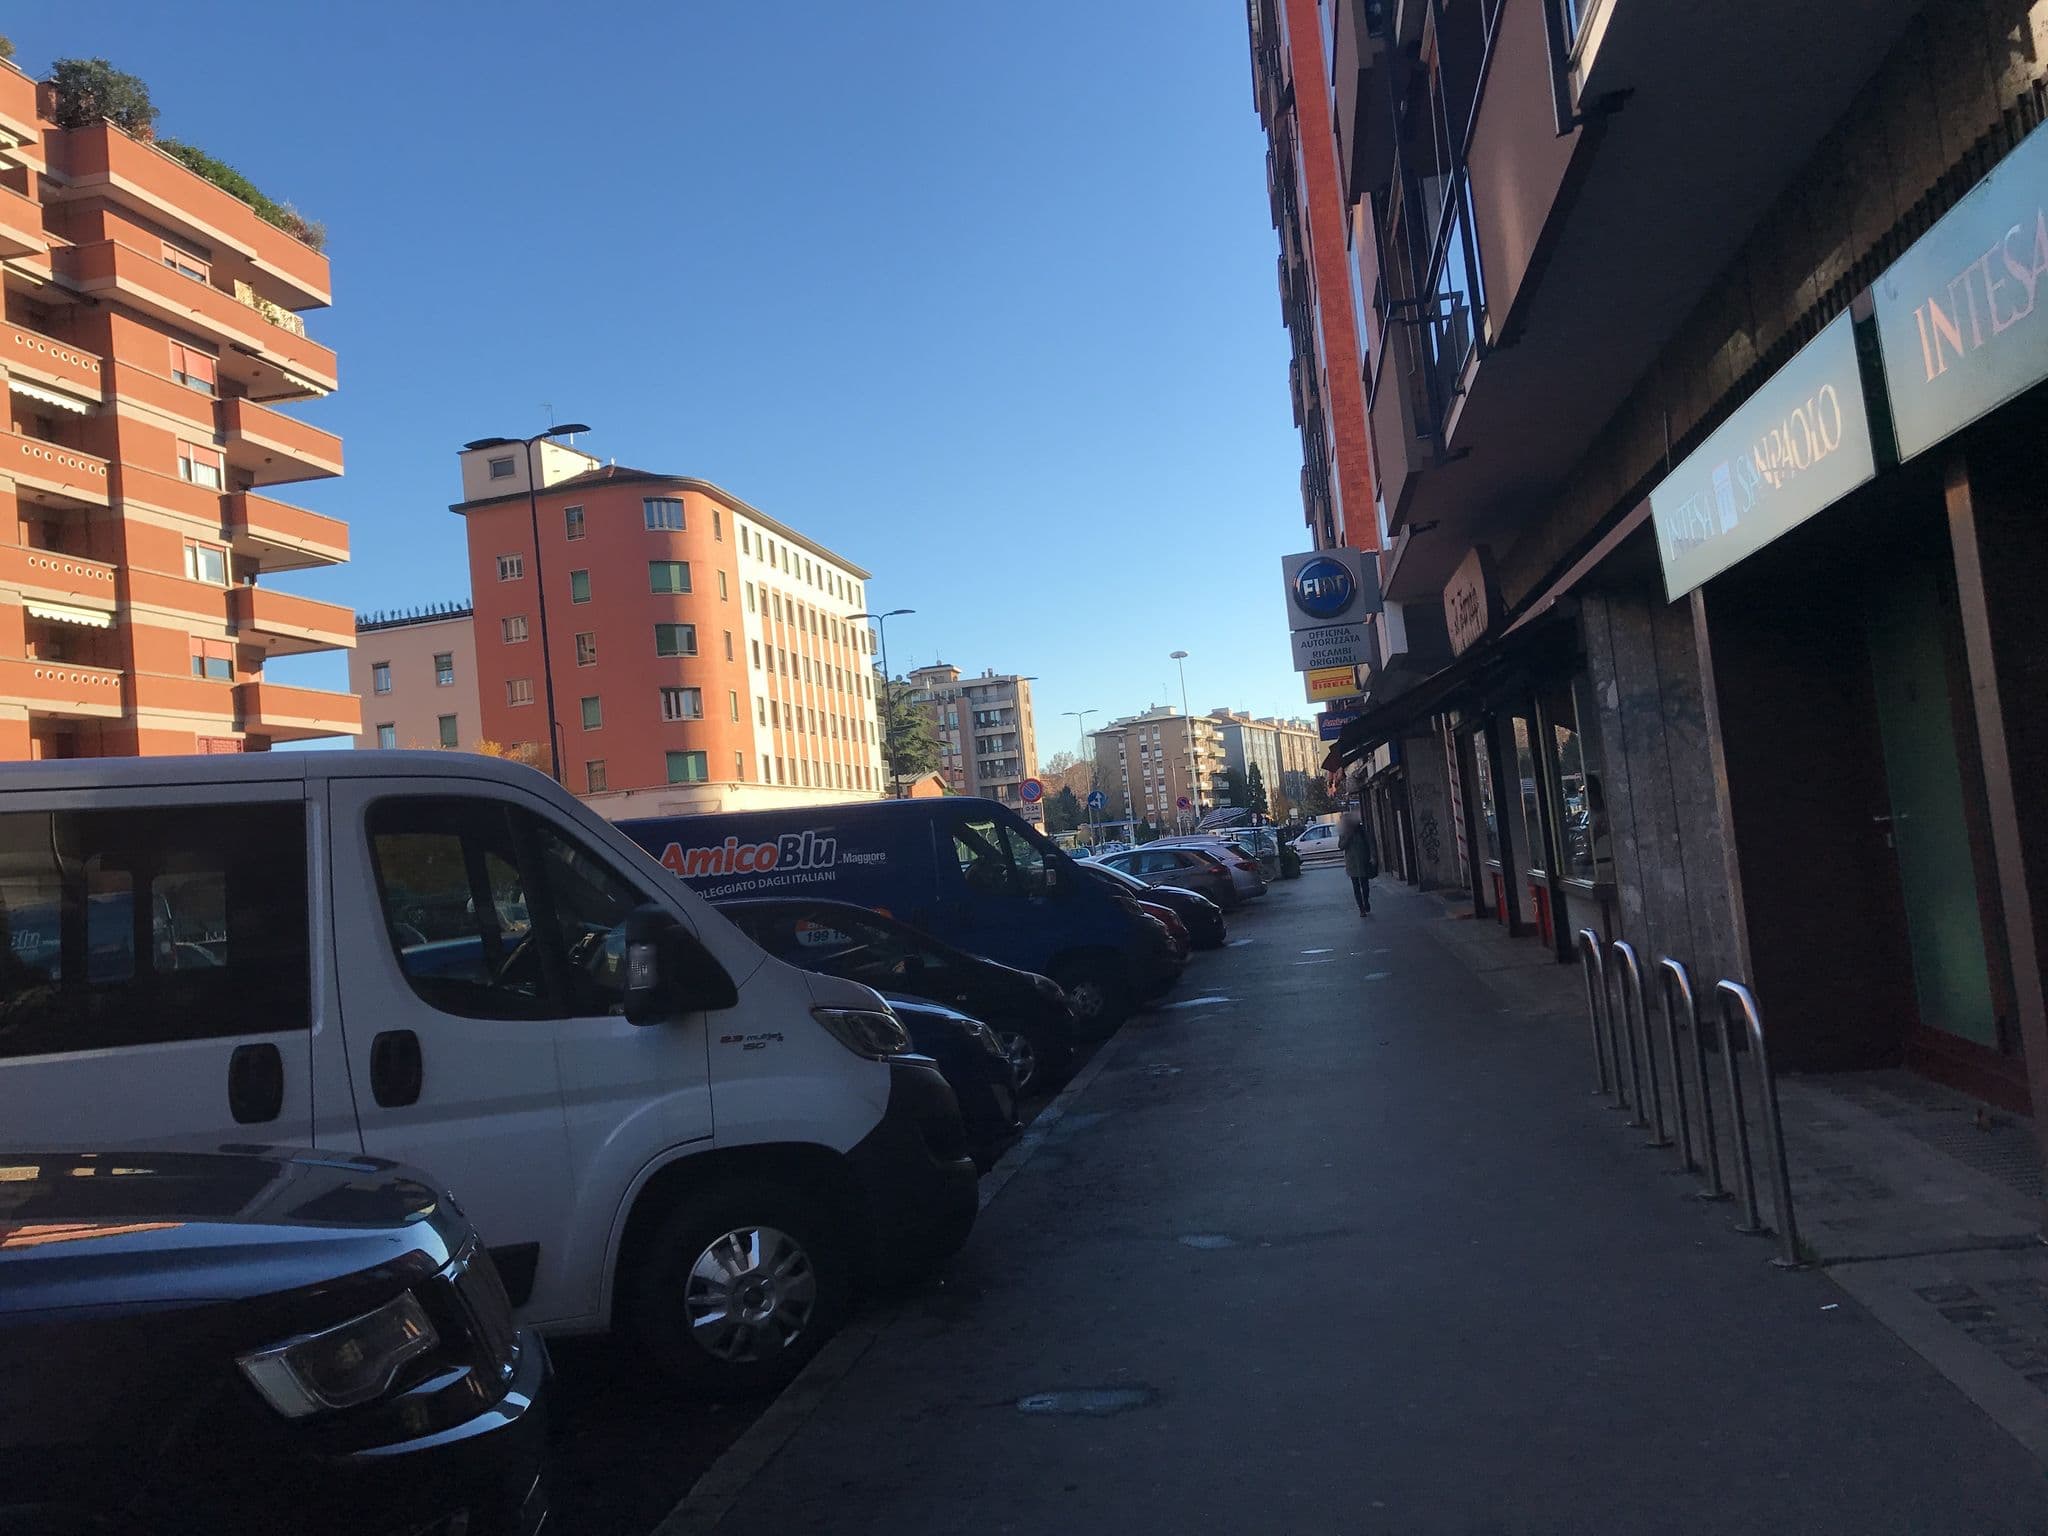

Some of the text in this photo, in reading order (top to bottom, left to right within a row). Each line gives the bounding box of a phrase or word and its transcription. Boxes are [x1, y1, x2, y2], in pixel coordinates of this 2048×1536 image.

[1736, 384, 1842, 513] SANPAOLO
[1302, 574, 1345, 599] FIAT
[1308, 627, 1350, 639] OFFICINA
[1300, 634, 1360, 648] AUTORIZZATA
[1312, 647, 1352, 658] RICAMBI
[1309, 655, 1357, 667] ORIGINALI
[1312, 675, 1353, 690] PIRELL
[660, 831, 837, 878] AmicoBlu
[842, 850, 886, 866] Maggiore
[697, 871, 836, 900] OLEGGIATO DAGLI ITALIANI
